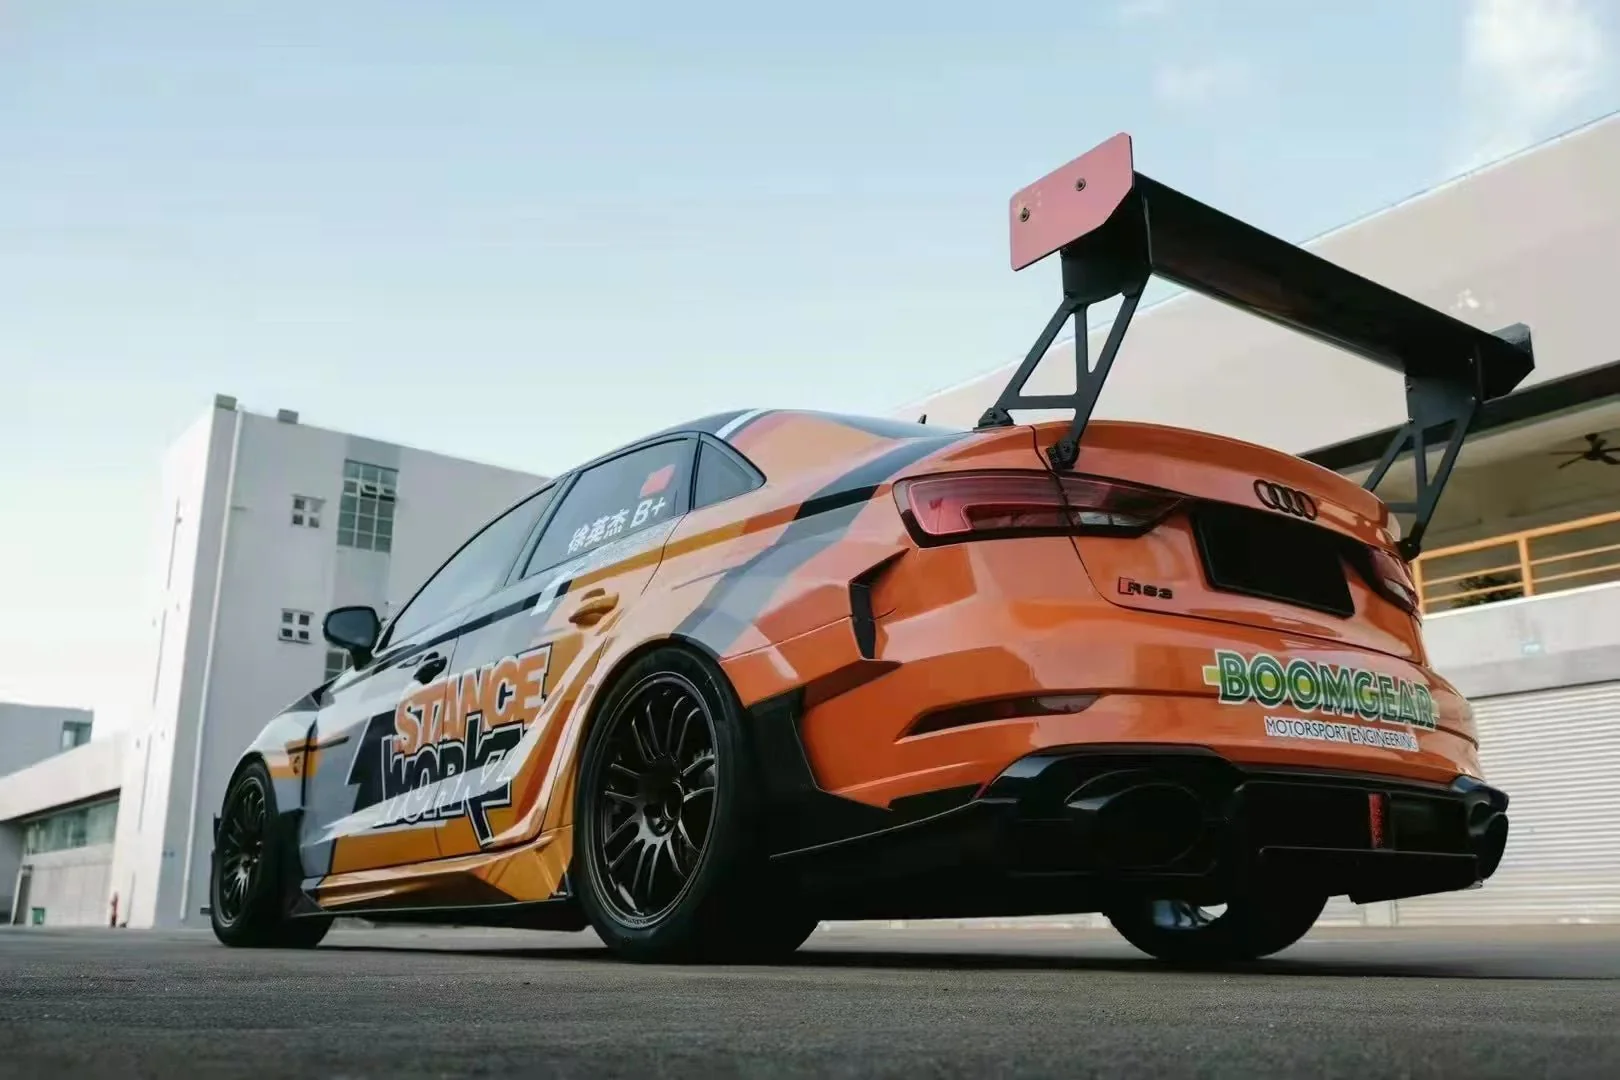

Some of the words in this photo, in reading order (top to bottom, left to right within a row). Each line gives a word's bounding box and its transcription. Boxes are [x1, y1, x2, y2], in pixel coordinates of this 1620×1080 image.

[629, 497, 667, 528] B+
[1127, 581, 1173, 600] RS3
[393, 643, 553, 758] STANCE
[1213, 649, 1436, 733] BOOMGEAR
[1266, 716, 1349, 743] MOTORSPORT
[1350, 727, 1418, 750] ENGINEERING
